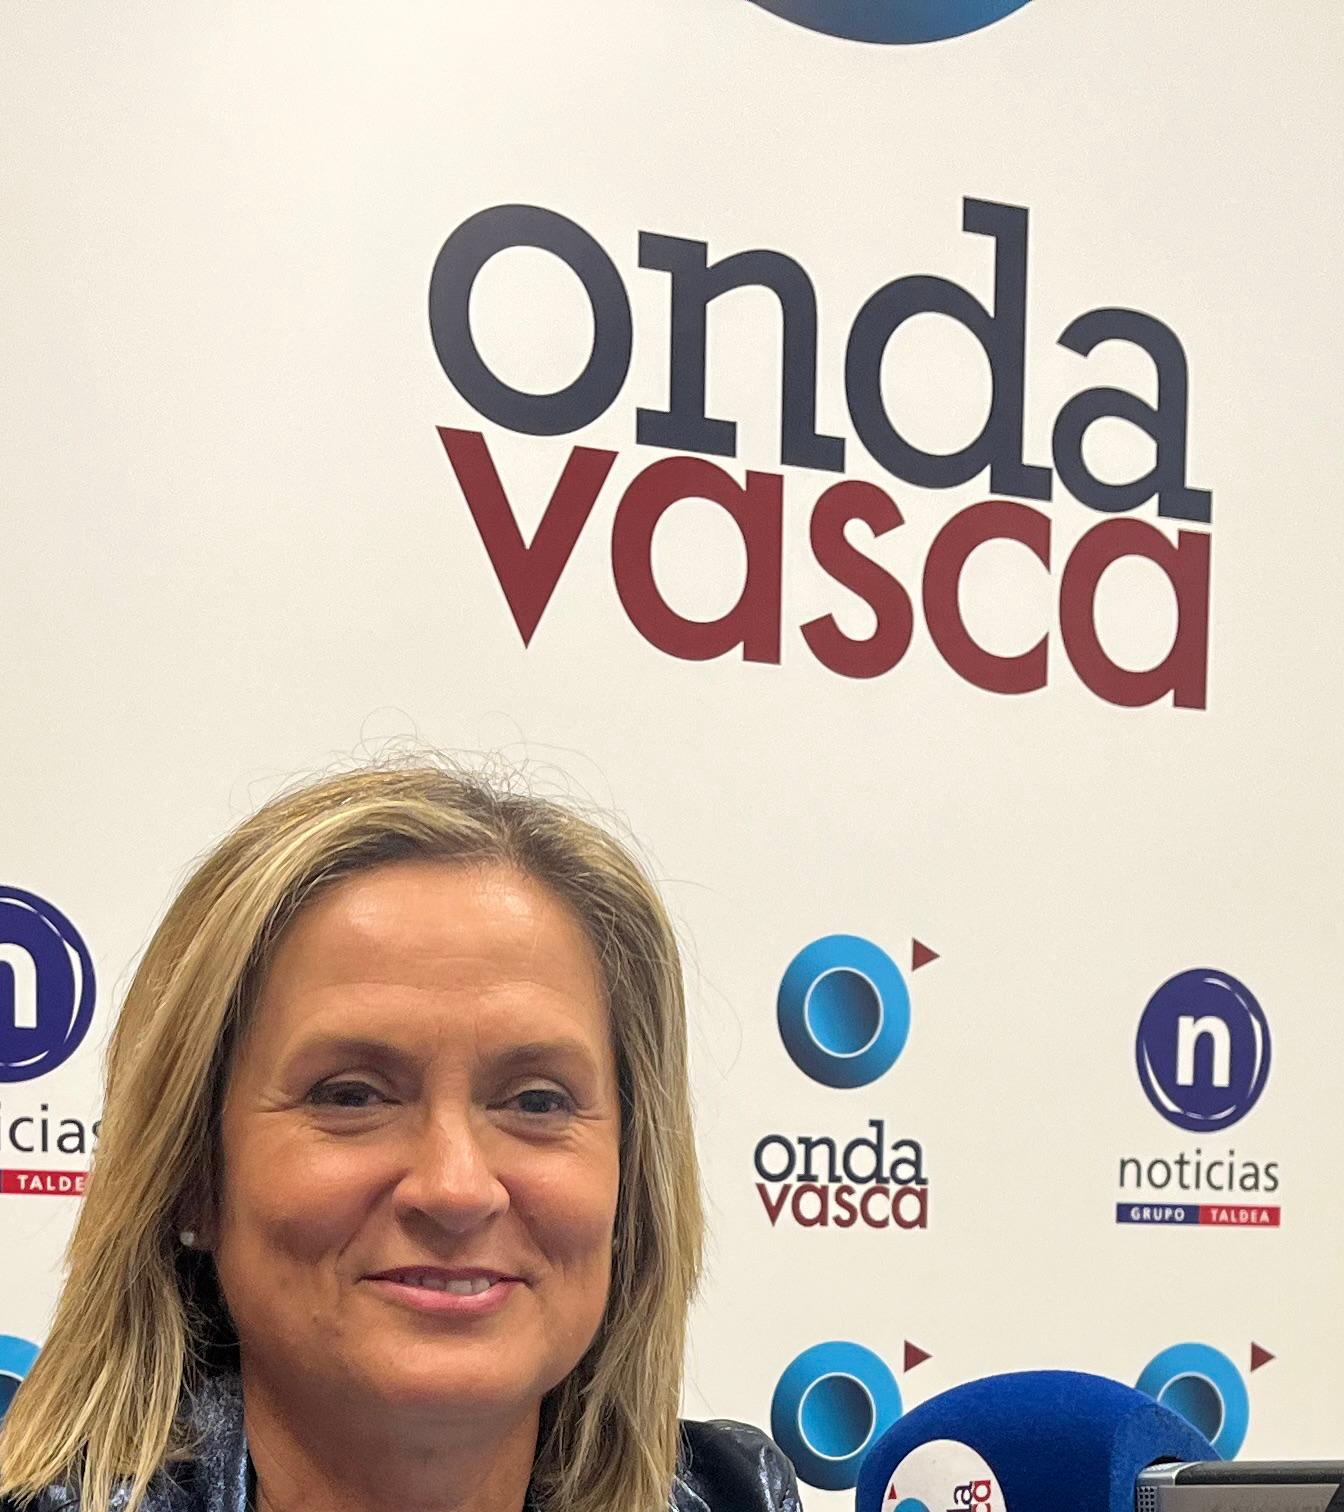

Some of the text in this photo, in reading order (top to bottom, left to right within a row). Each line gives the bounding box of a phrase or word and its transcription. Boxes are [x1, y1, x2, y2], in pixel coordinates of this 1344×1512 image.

[428, 196, 1213, 524] onda
[436, 426, 1212, 711] vasca
[1176, 1016, 1231, 1087] n
[754, 1120, 928, 1185] onda
[1119, 1148, 1279, 1192] noticias
[17, 1174, 85, 1192] TALDE
[755, 1182, 927, 1230] vasca
[1131, 1206, 1269, 1223] GRUPO TALDEA
